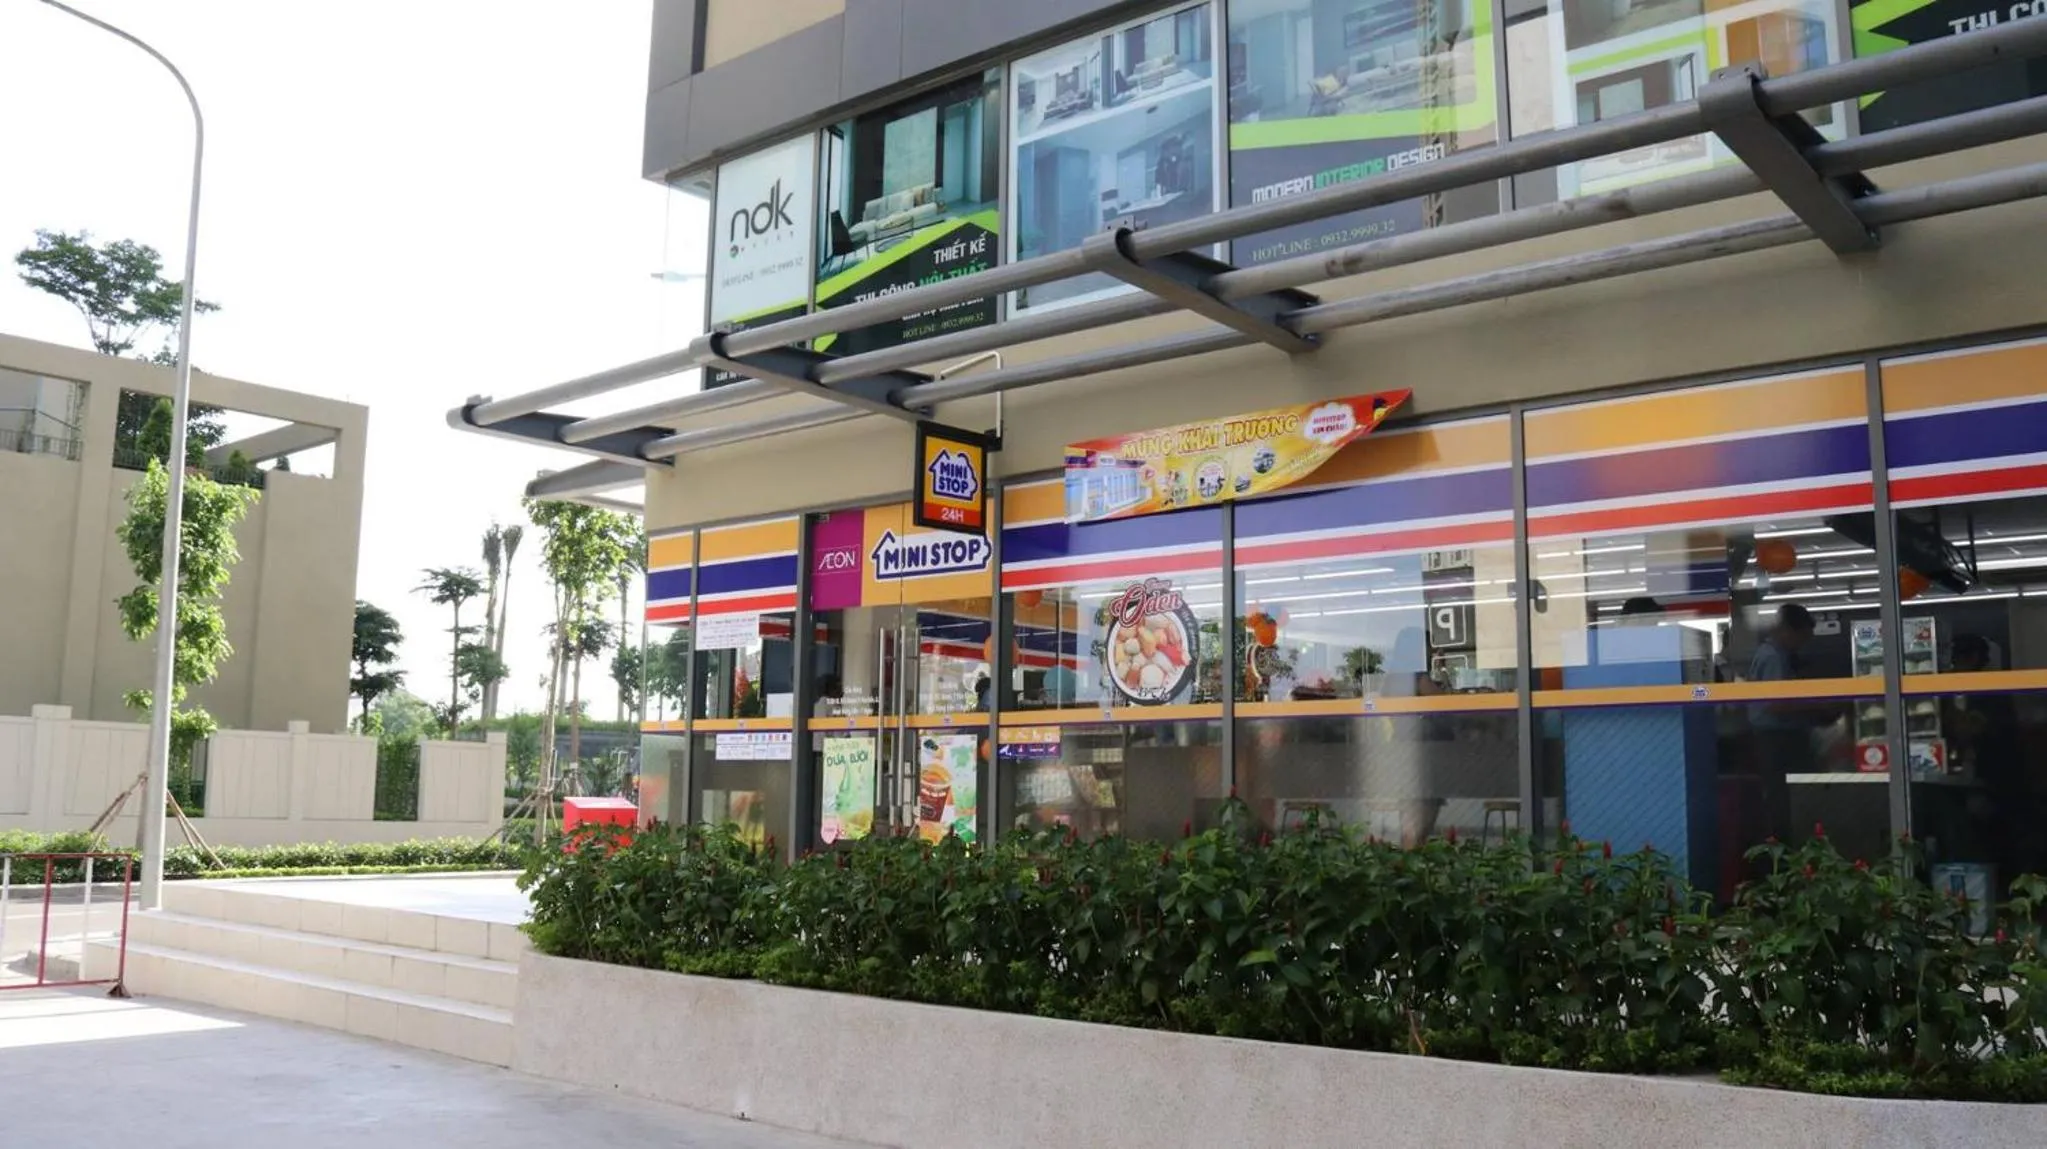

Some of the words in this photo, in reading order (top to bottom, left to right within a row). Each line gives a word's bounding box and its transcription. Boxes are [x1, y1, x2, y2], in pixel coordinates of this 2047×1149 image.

[1315, 157, 1386, 191] INTERIOR
[1387, 143, 1445, 172] DESIGN
[730, 177, 794, 242] ndk
[1178, 424, 1220, 453] KHAI
[939, 462, 968, 480] MINI
[938, 477, 969, 494] STOP
[941, 507, 964, 523] 24H
